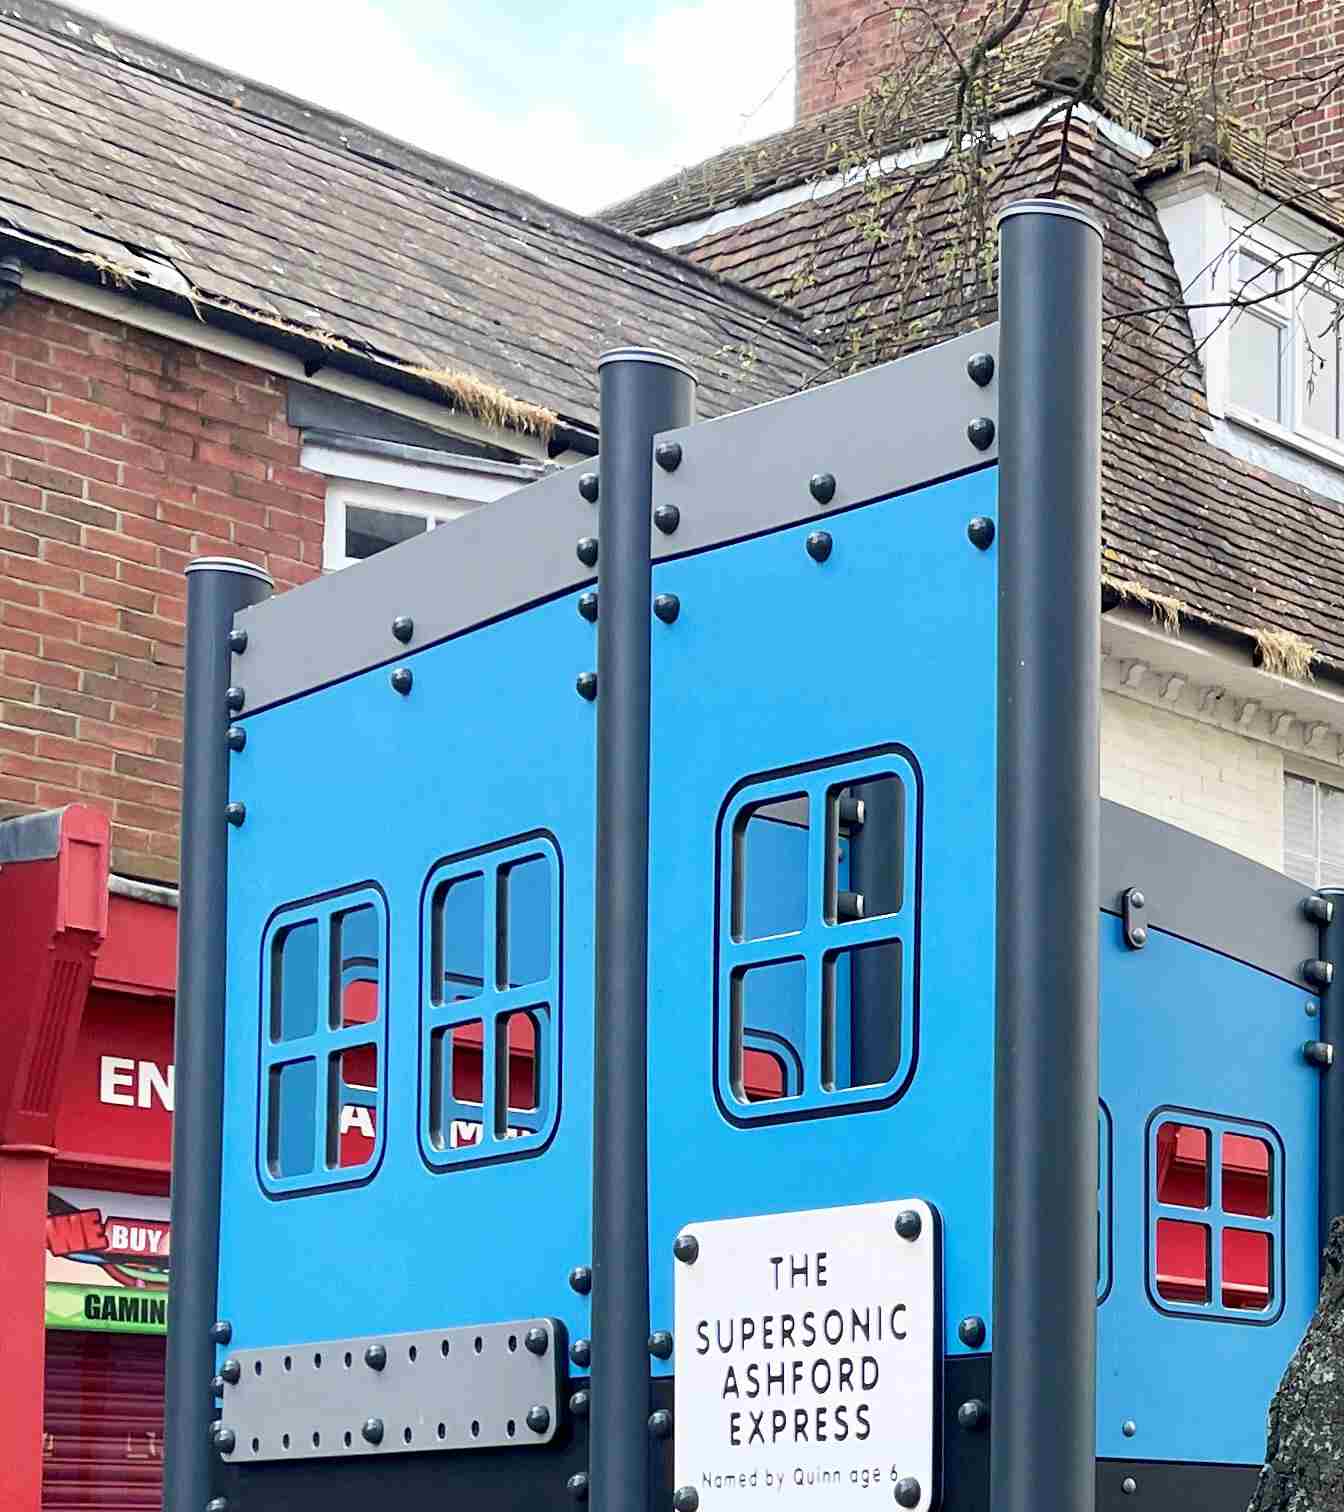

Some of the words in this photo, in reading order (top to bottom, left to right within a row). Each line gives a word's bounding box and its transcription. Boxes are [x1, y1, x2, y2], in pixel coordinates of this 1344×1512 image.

[112, 1224, 162, 1253] BUY
[769, 1251, 829, 1291] THE
[84, 1293, 166, 1325] GAMIN
[696, 1303, 908, 1355] SUPERSONIC
[722, 1356, 880, 1400] ASHFORD
[729, 1403, 872, 1446] EXPRESS
[702, 1466, 758, 1490] Named
[764, 1467, 785, 1492] by
[793, 1466, 842, 1486] Quinn
[849, 1468, 881, 1488] age
[889, 1463, 899, 1482] 6
